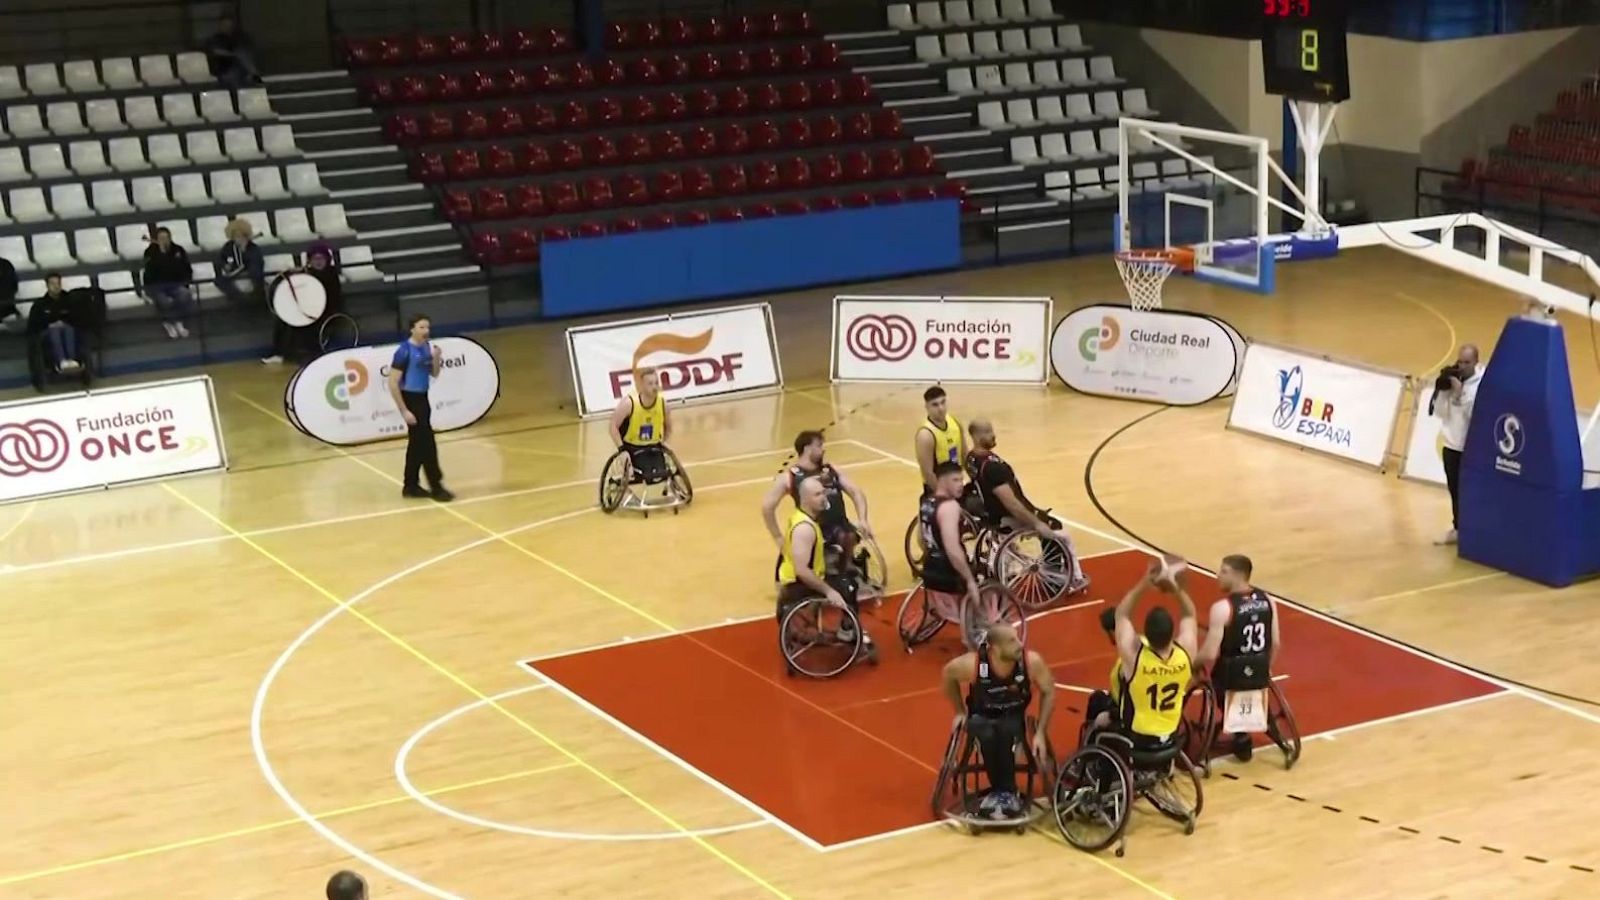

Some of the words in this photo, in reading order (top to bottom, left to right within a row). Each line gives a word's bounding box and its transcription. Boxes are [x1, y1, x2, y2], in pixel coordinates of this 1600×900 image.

[1302, 29, 1318, 71] 8
[926, 319, 1012, 335] Fundación
[1130, 329, 1177, 345] Ciudad
[1181, 334, 1210, 348] Real
[924, 337, 1011, 359] ONCE
[76, 407, 174, 433] Fundación
[1296, 419, 1351, 448] ESPAÑA
[81, 425, 179, 461] ONCE
[1241, 623, 1265, 653] 33
[1146, 683, 1179, 711] 12
